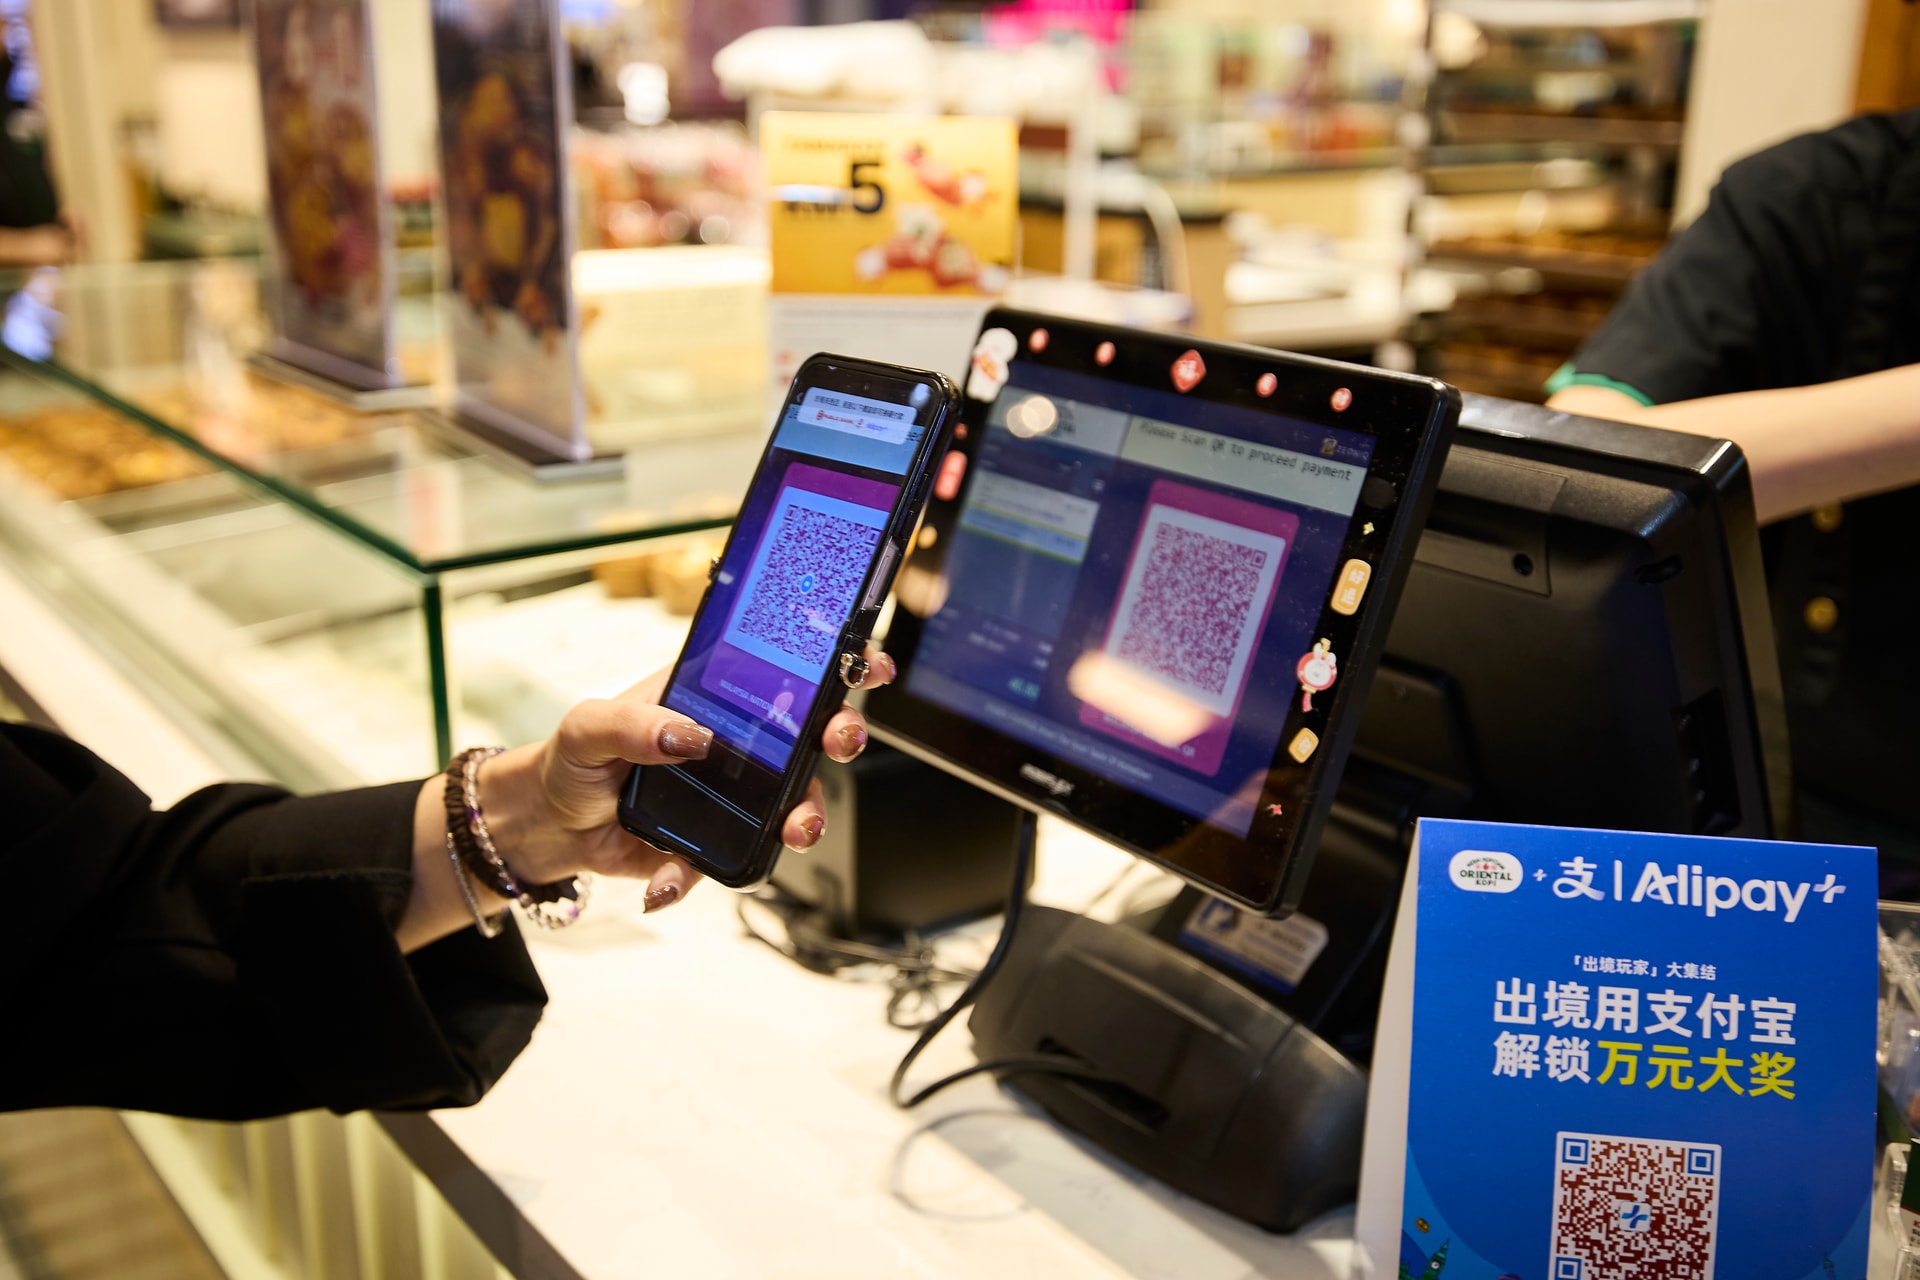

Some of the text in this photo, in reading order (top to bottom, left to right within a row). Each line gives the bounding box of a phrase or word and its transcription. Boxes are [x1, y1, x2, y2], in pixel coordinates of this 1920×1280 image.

[851, 161, 884, 215] 5
[1181, 430, 1207, 446] Scan
[1211, 436, 1226, 451] QR
[1231, 441, 1245, 455] to
[1248, 447, 1297, 468] proceed
[1301, 459, 1352, 481] payment
[1459, 869, 1513, 881] ORIENTAL
[1475, 879, 1497, 887] KOPI
[1552, 856, 1605, 901] 支
[1493, 977, 1797, 1045] 出境用支付宝
[1493, 1030, 1797, 1100] 解锁万元大奖
